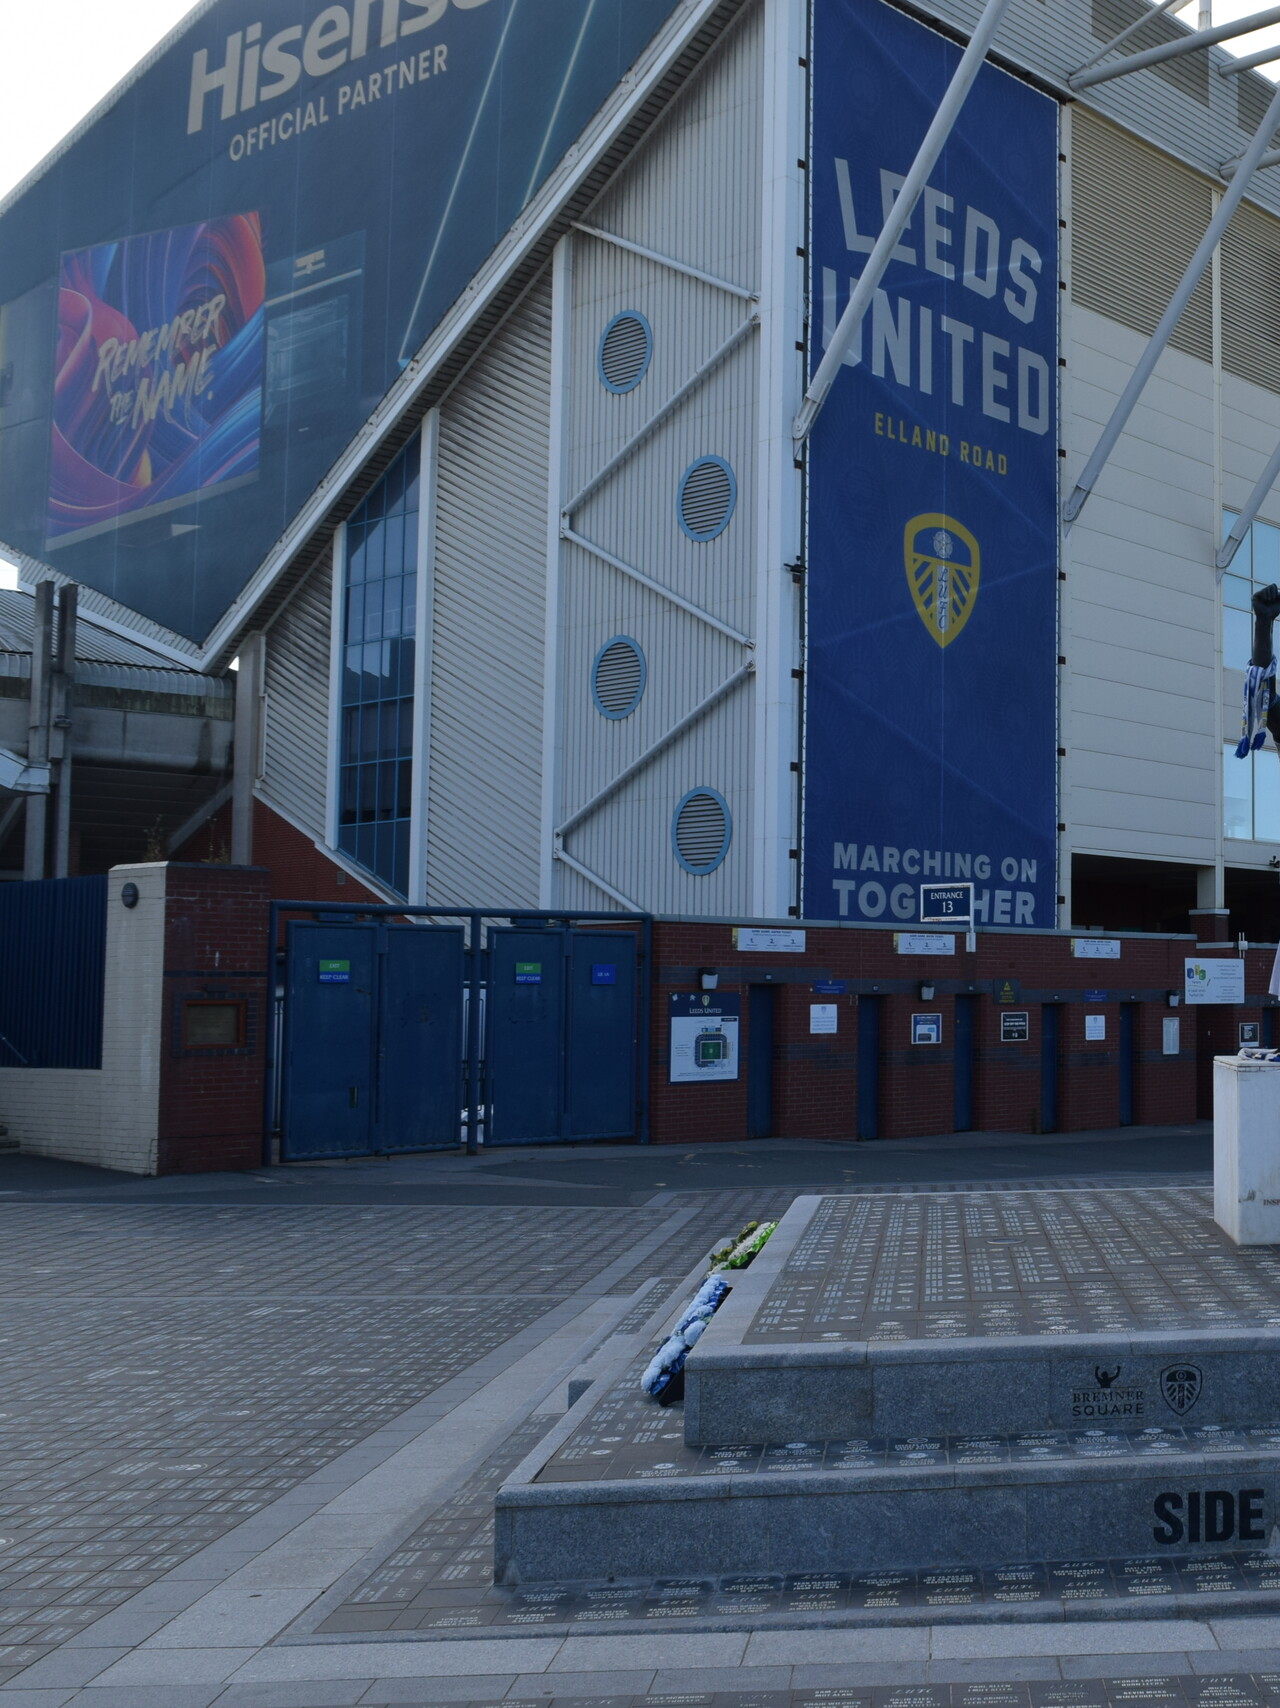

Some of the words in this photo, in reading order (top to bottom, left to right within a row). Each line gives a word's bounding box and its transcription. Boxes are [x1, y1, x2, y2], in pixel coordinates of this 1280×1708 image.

[186, 0, 504, 136] Hisens
[229, 96, 329, 162] OFFICIAL
[337, 43, 449, 115] PARTNER
[834, 157, 1042, 324] LEEDS
[92, 293, 227, 398] REMEMBER
[821, 266, 1050, 436] UNITED
[874, 411, 950, 457] ELLAND
[960, 440, 1008, 476] ROAD
[833, 842, 991, 880] MARCHING
[1000, 856, 1037, 884] ON
[832, 879, 1036, 925] TOGHER
[930, 891, 964, 900] ENTRANCE
[942, 901, 954, 914] 13
[1072, 1389, 1144, 1404] BREMNER
[1072, 1403, 1144, 1417] SQUARE
[1153, 1489, 1266, 1545] SIDE
